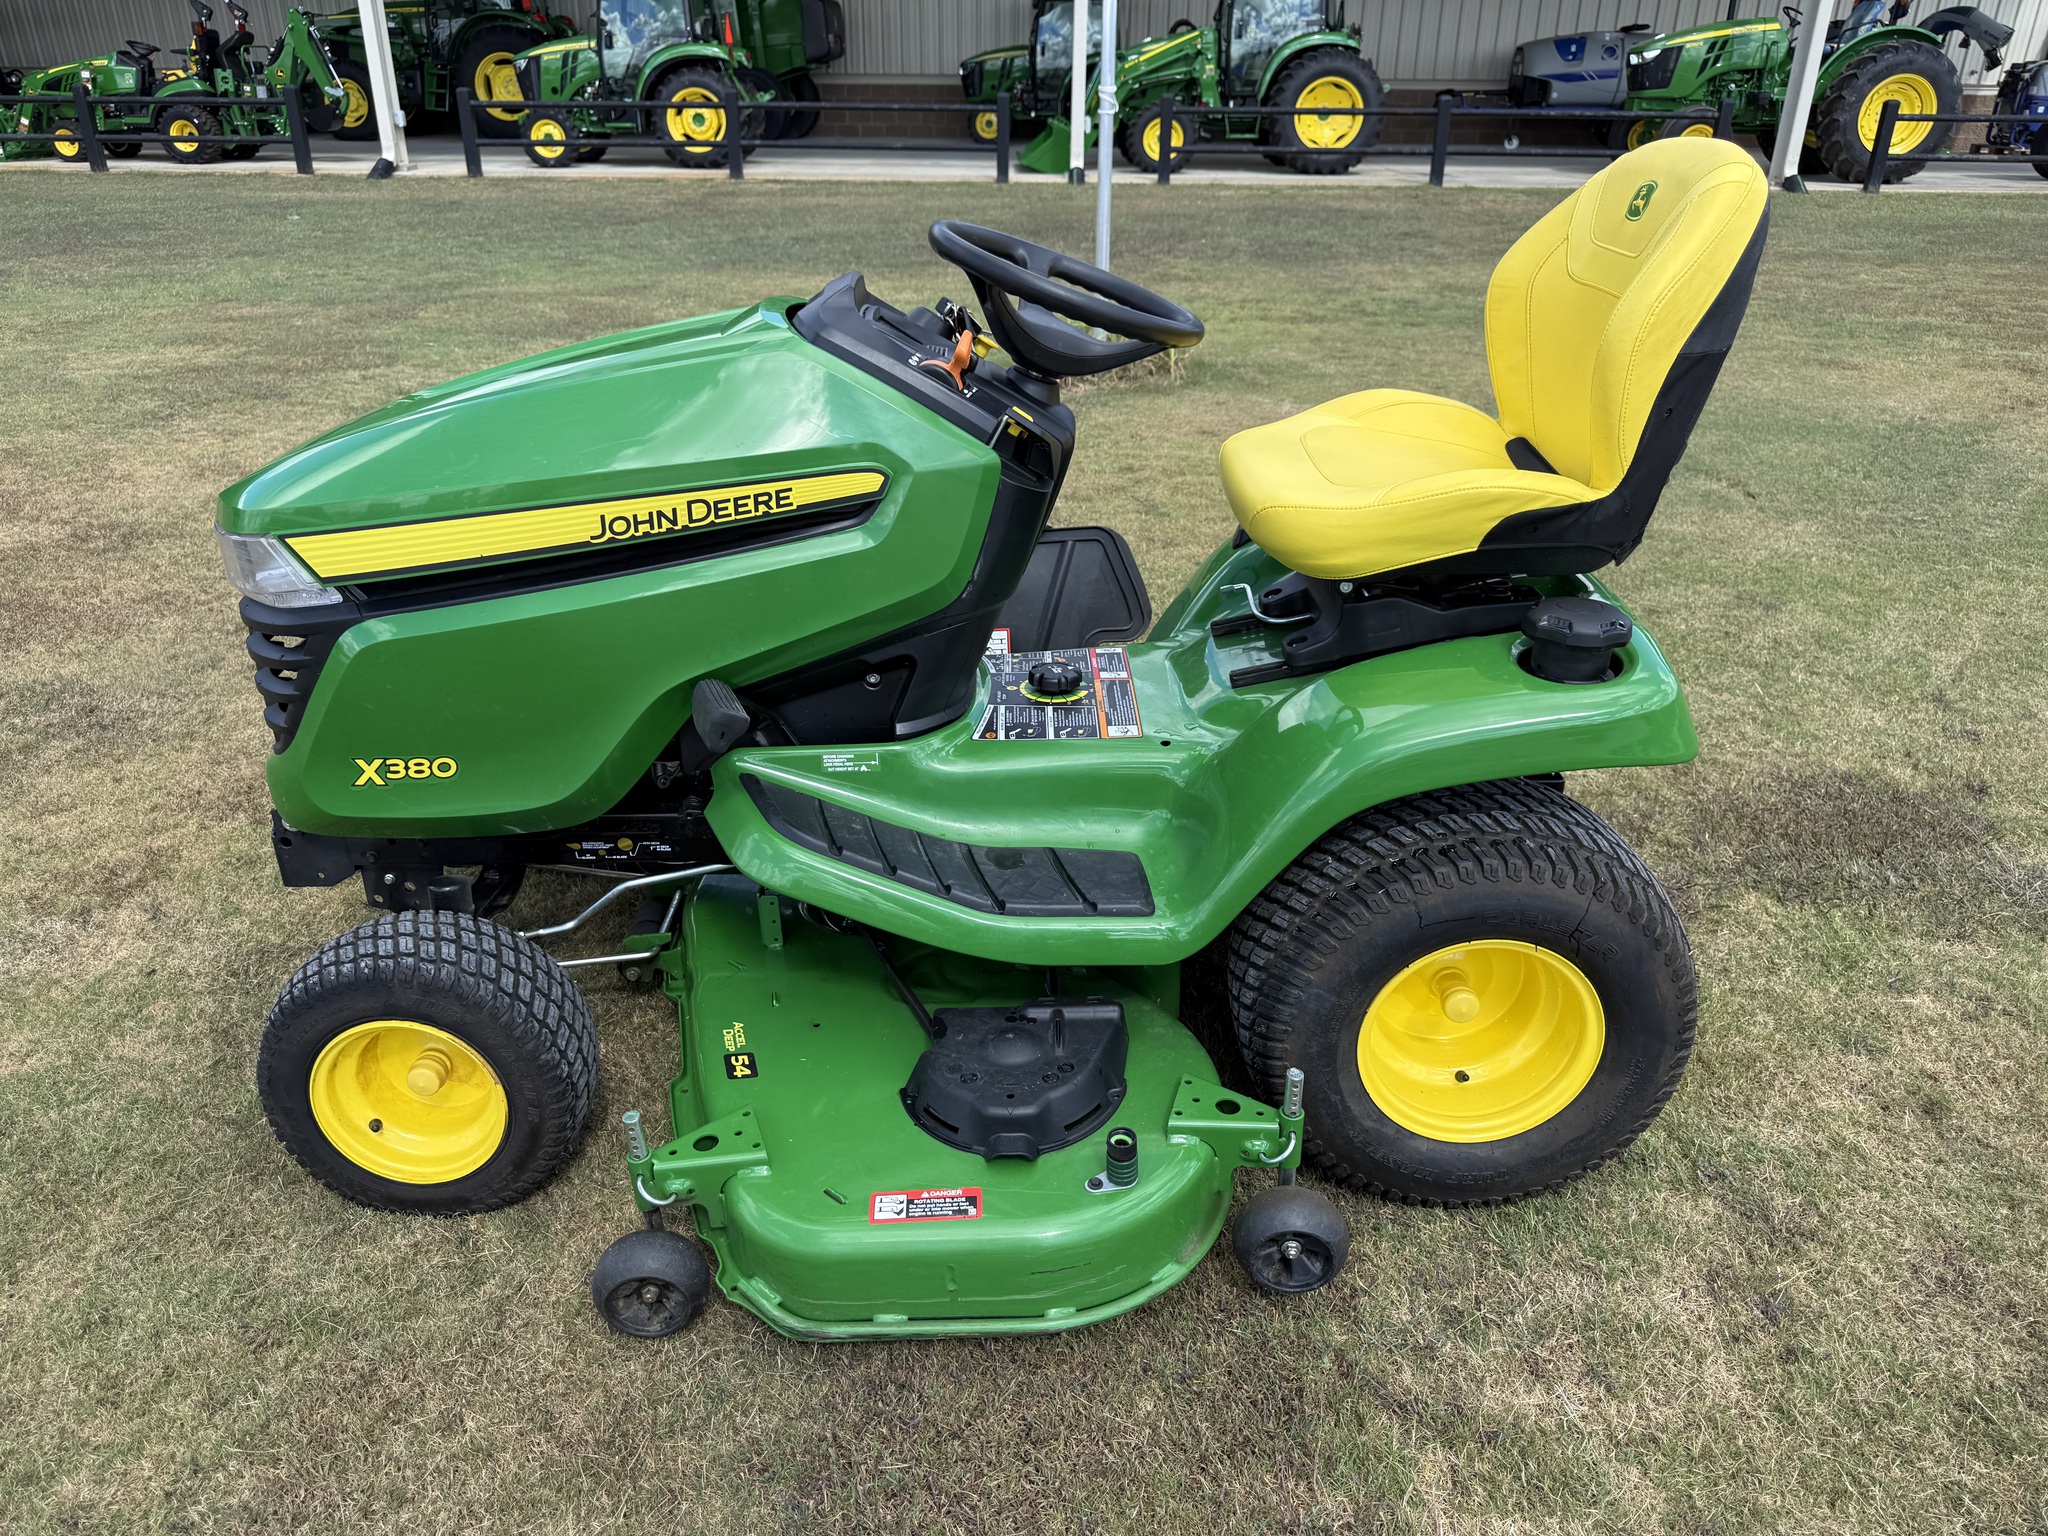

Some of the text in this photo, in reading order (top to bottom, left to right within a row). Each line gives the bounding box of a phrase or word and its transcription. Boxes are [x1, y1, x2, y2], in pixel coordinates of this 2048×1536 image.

[590, 487, 794, 541] JOHN DEERE
[351, 757, 458, 787] X380
[722, 1028, 736, 1052] DEEP
[732, 1022, 746, 1048] ACCEL
[730, 1054, 752, 1078] 54
